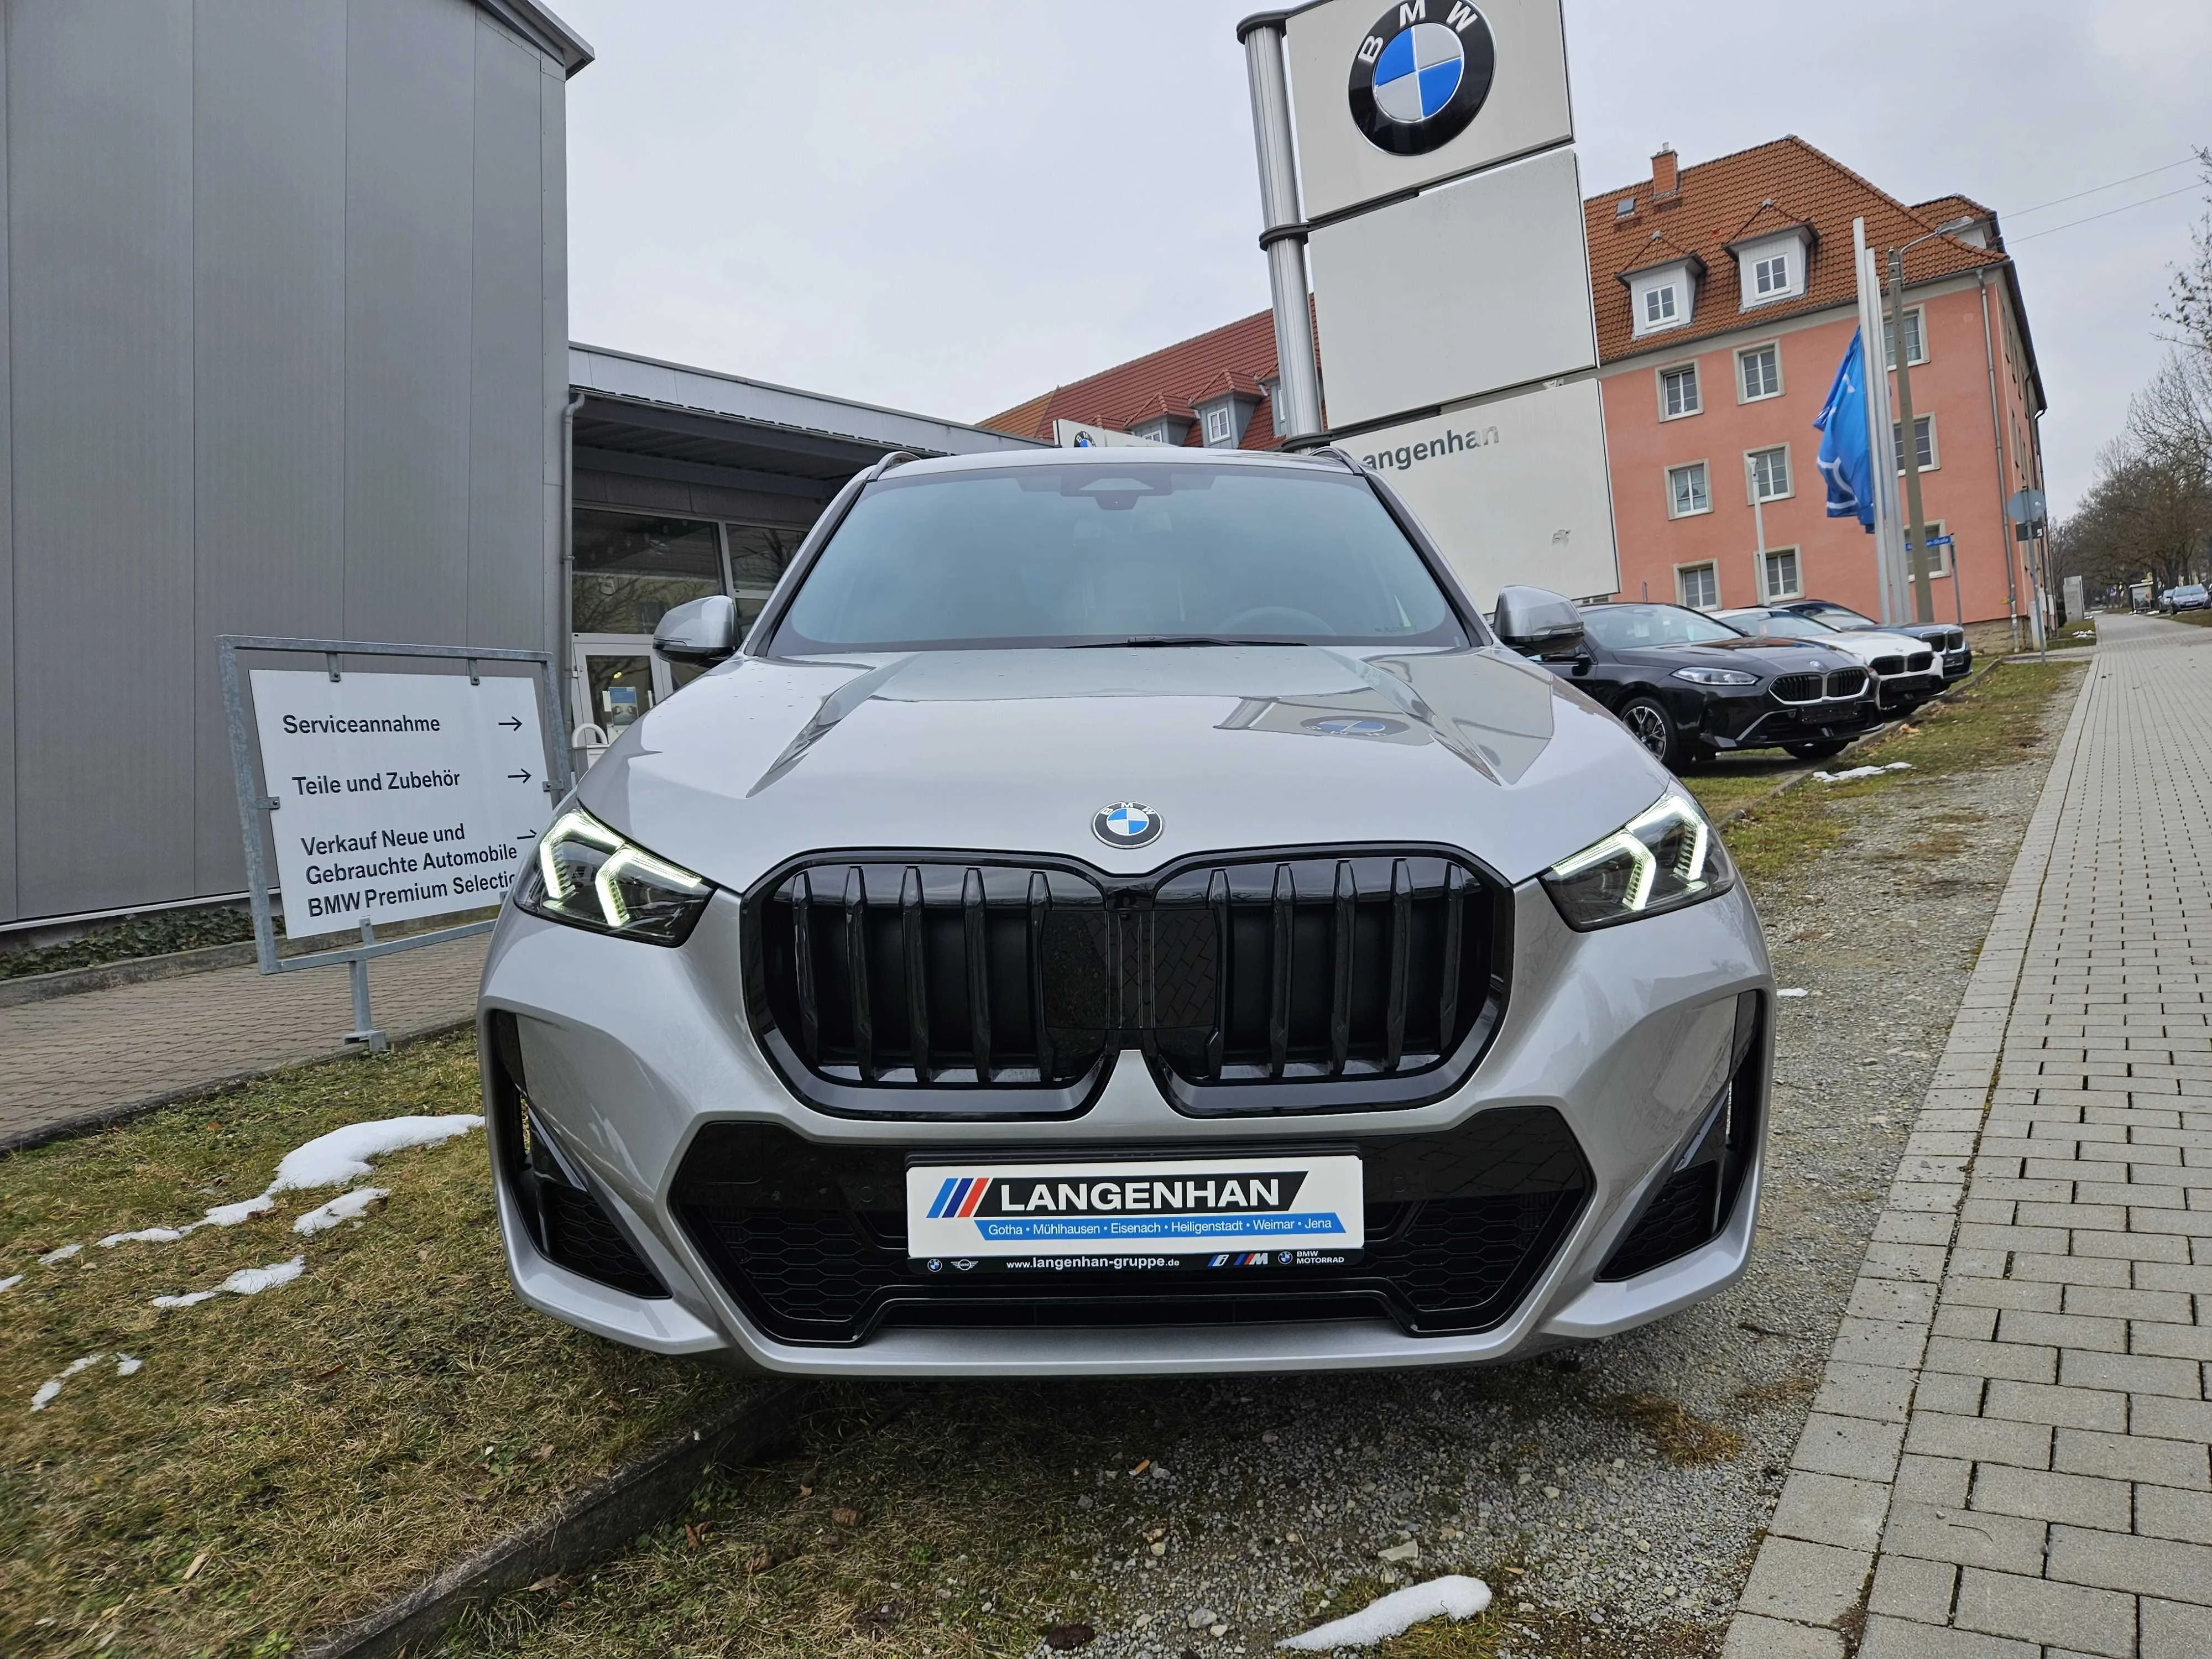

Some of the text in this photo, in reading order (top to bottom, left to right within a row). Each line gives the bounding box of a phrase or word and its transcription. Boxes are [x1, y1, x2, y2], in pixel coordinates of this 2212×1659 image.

[1358, 0, 1478, 63] BMW
[1363, 426, 1500, 470] angenhan
[283, 714, 440, 734] Serviceannahme
[292, 769, 460, 795] Teile und Zubehör
[1100, 802, 1155, 815] BMW
[300, 823, 465, 856] Verkauf Neue und
[306, 844, 517, 884] Gebrauchte Automobile
[307, 891, 360, 917] BMW
[366, 883, 447, 908] Premium
[1001, 1179, 1279, 1211] LANGENHAN
[988, 1218, 1332, 1235] Gotha Mühlhausen Eisenach Heiligenstadt Weimar Jena
[1006, 1256, 1180, 1270] www.langenhan-gruppe.de
